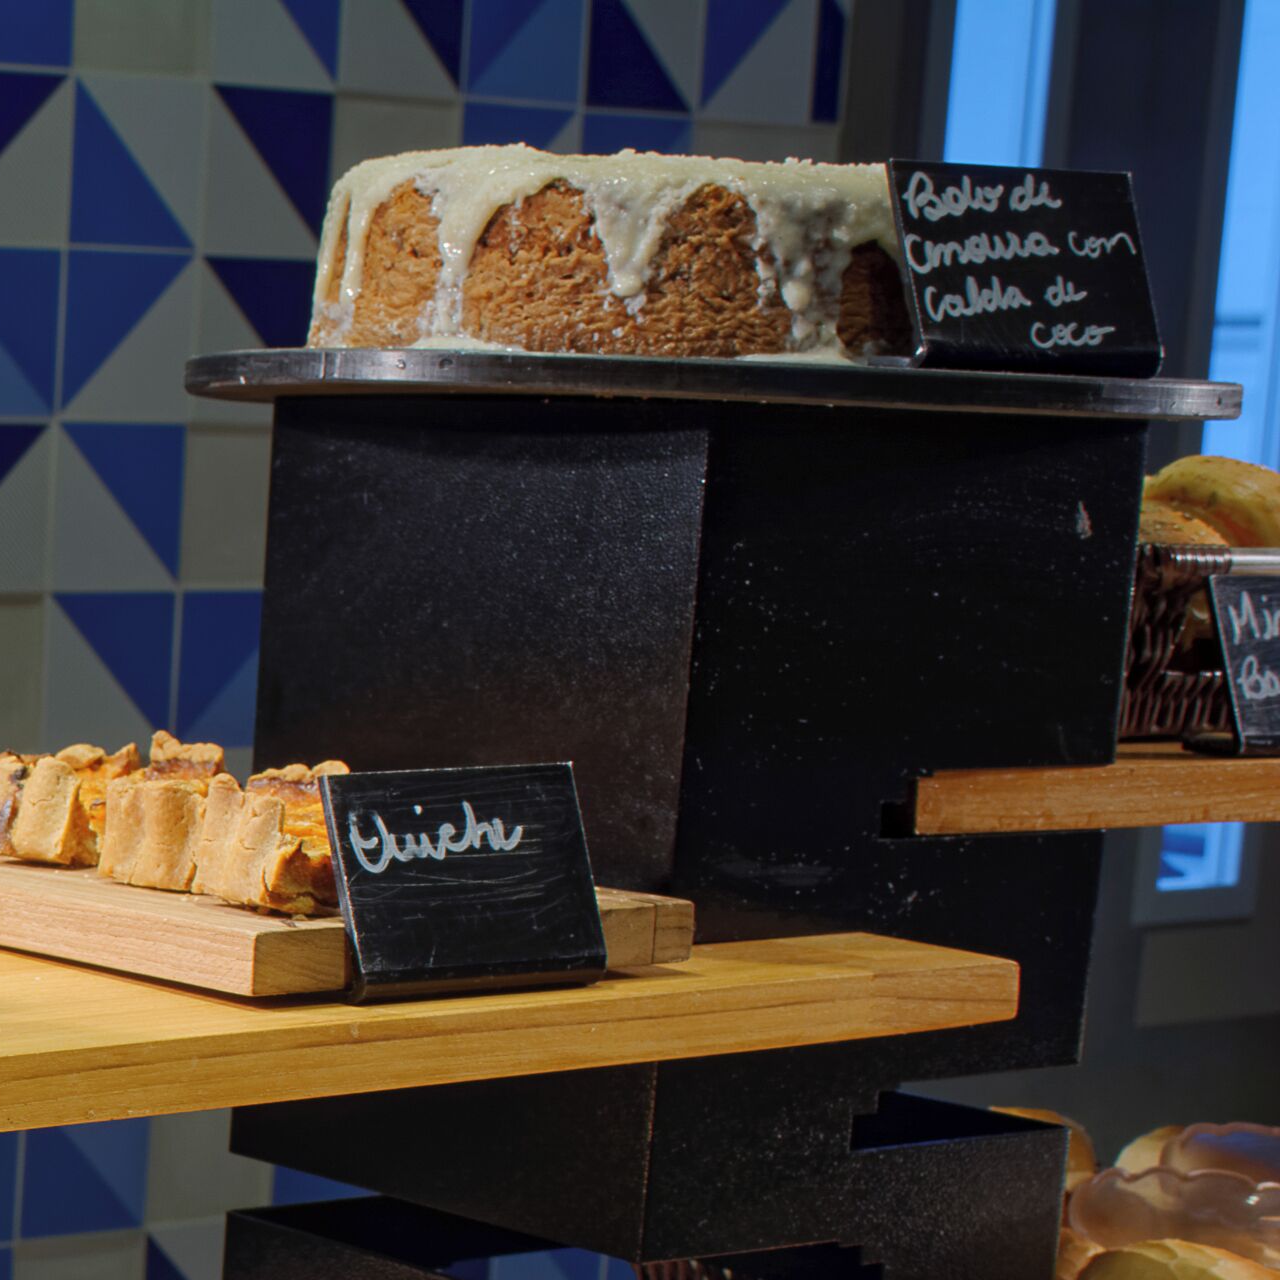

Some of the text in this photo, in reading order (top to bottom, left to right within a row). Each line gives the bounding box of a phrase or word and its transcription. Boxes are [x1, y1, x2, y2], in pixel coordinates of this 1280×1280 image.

[1009, 173, 1062, 211] de
[1044, 275, 1088, 306] de
[349, 800, 523, 873] Quiche
